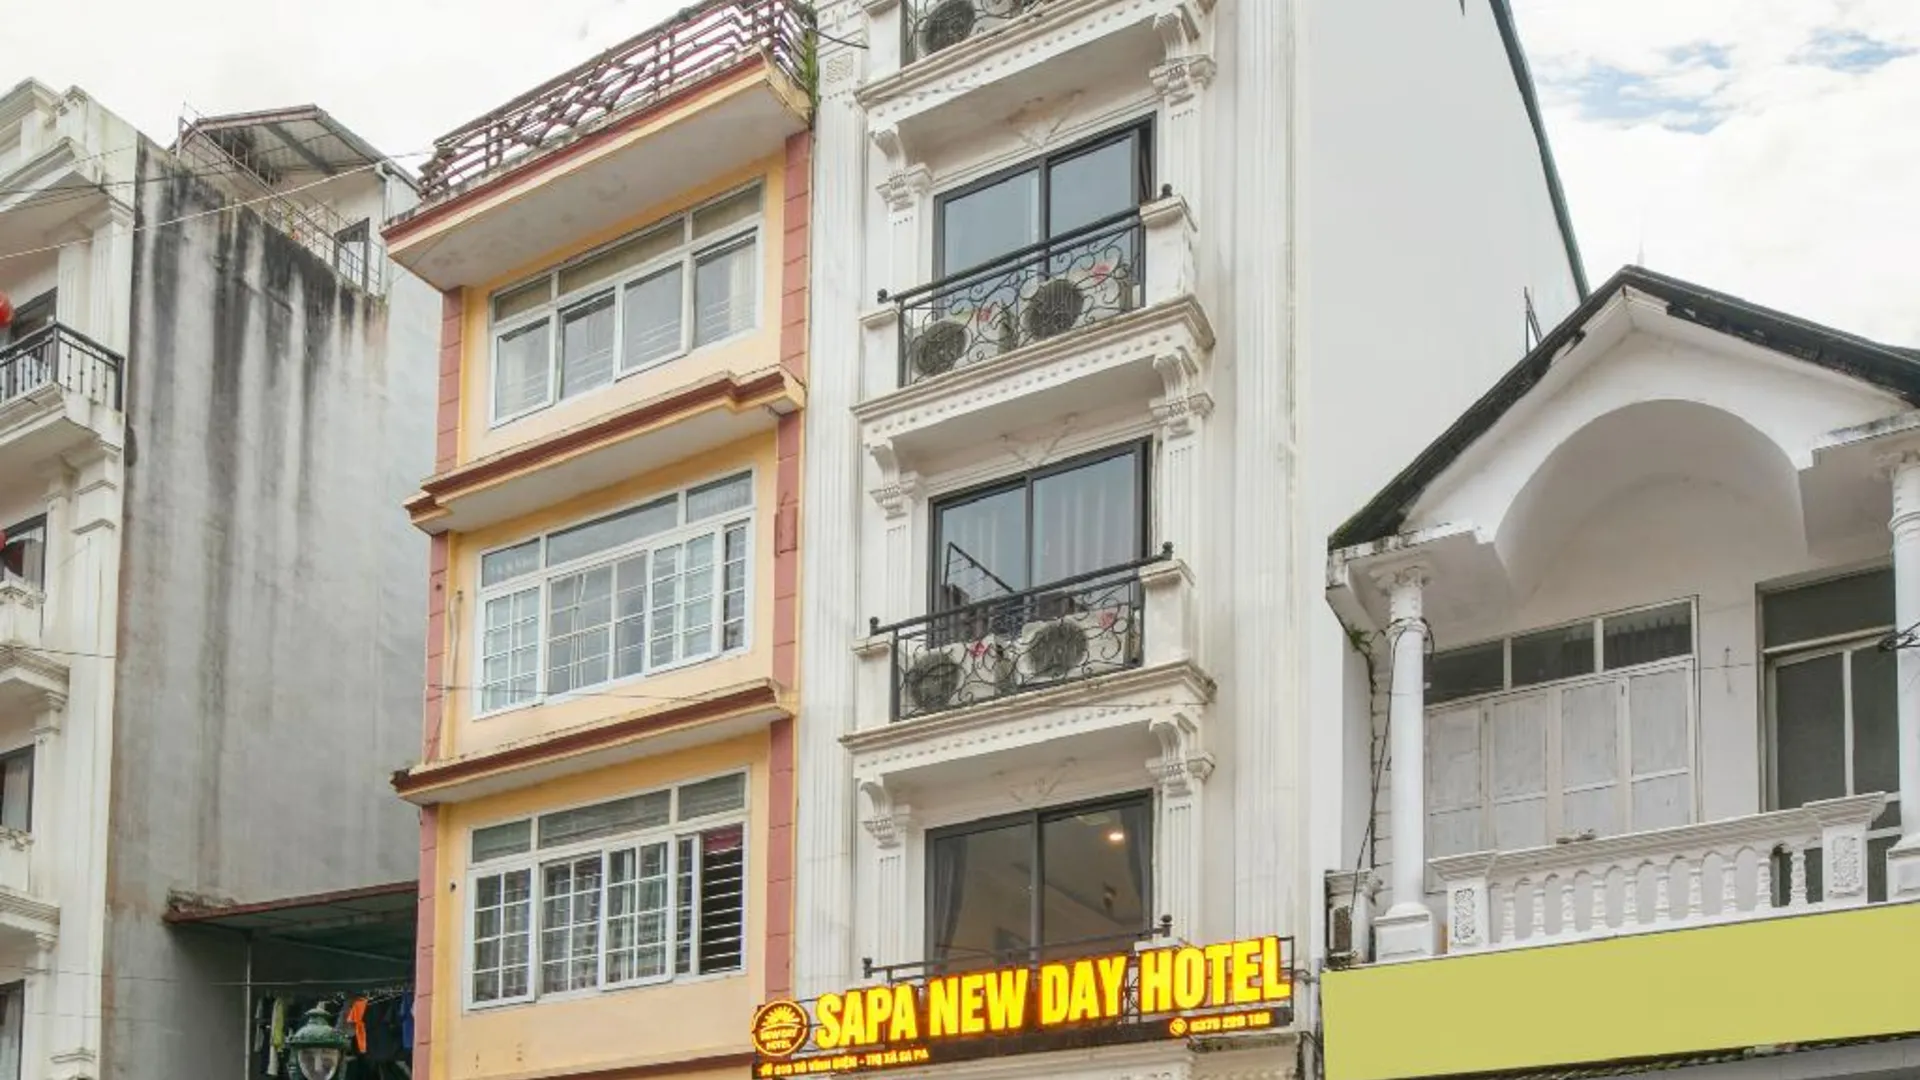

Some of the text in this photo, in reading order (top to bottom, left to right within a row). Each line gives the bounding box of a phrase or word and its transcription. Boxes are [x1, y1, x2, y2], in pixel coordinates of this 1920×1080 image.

[813, 935, 1291, 1049] SAPA NEW DAY HOTEL
